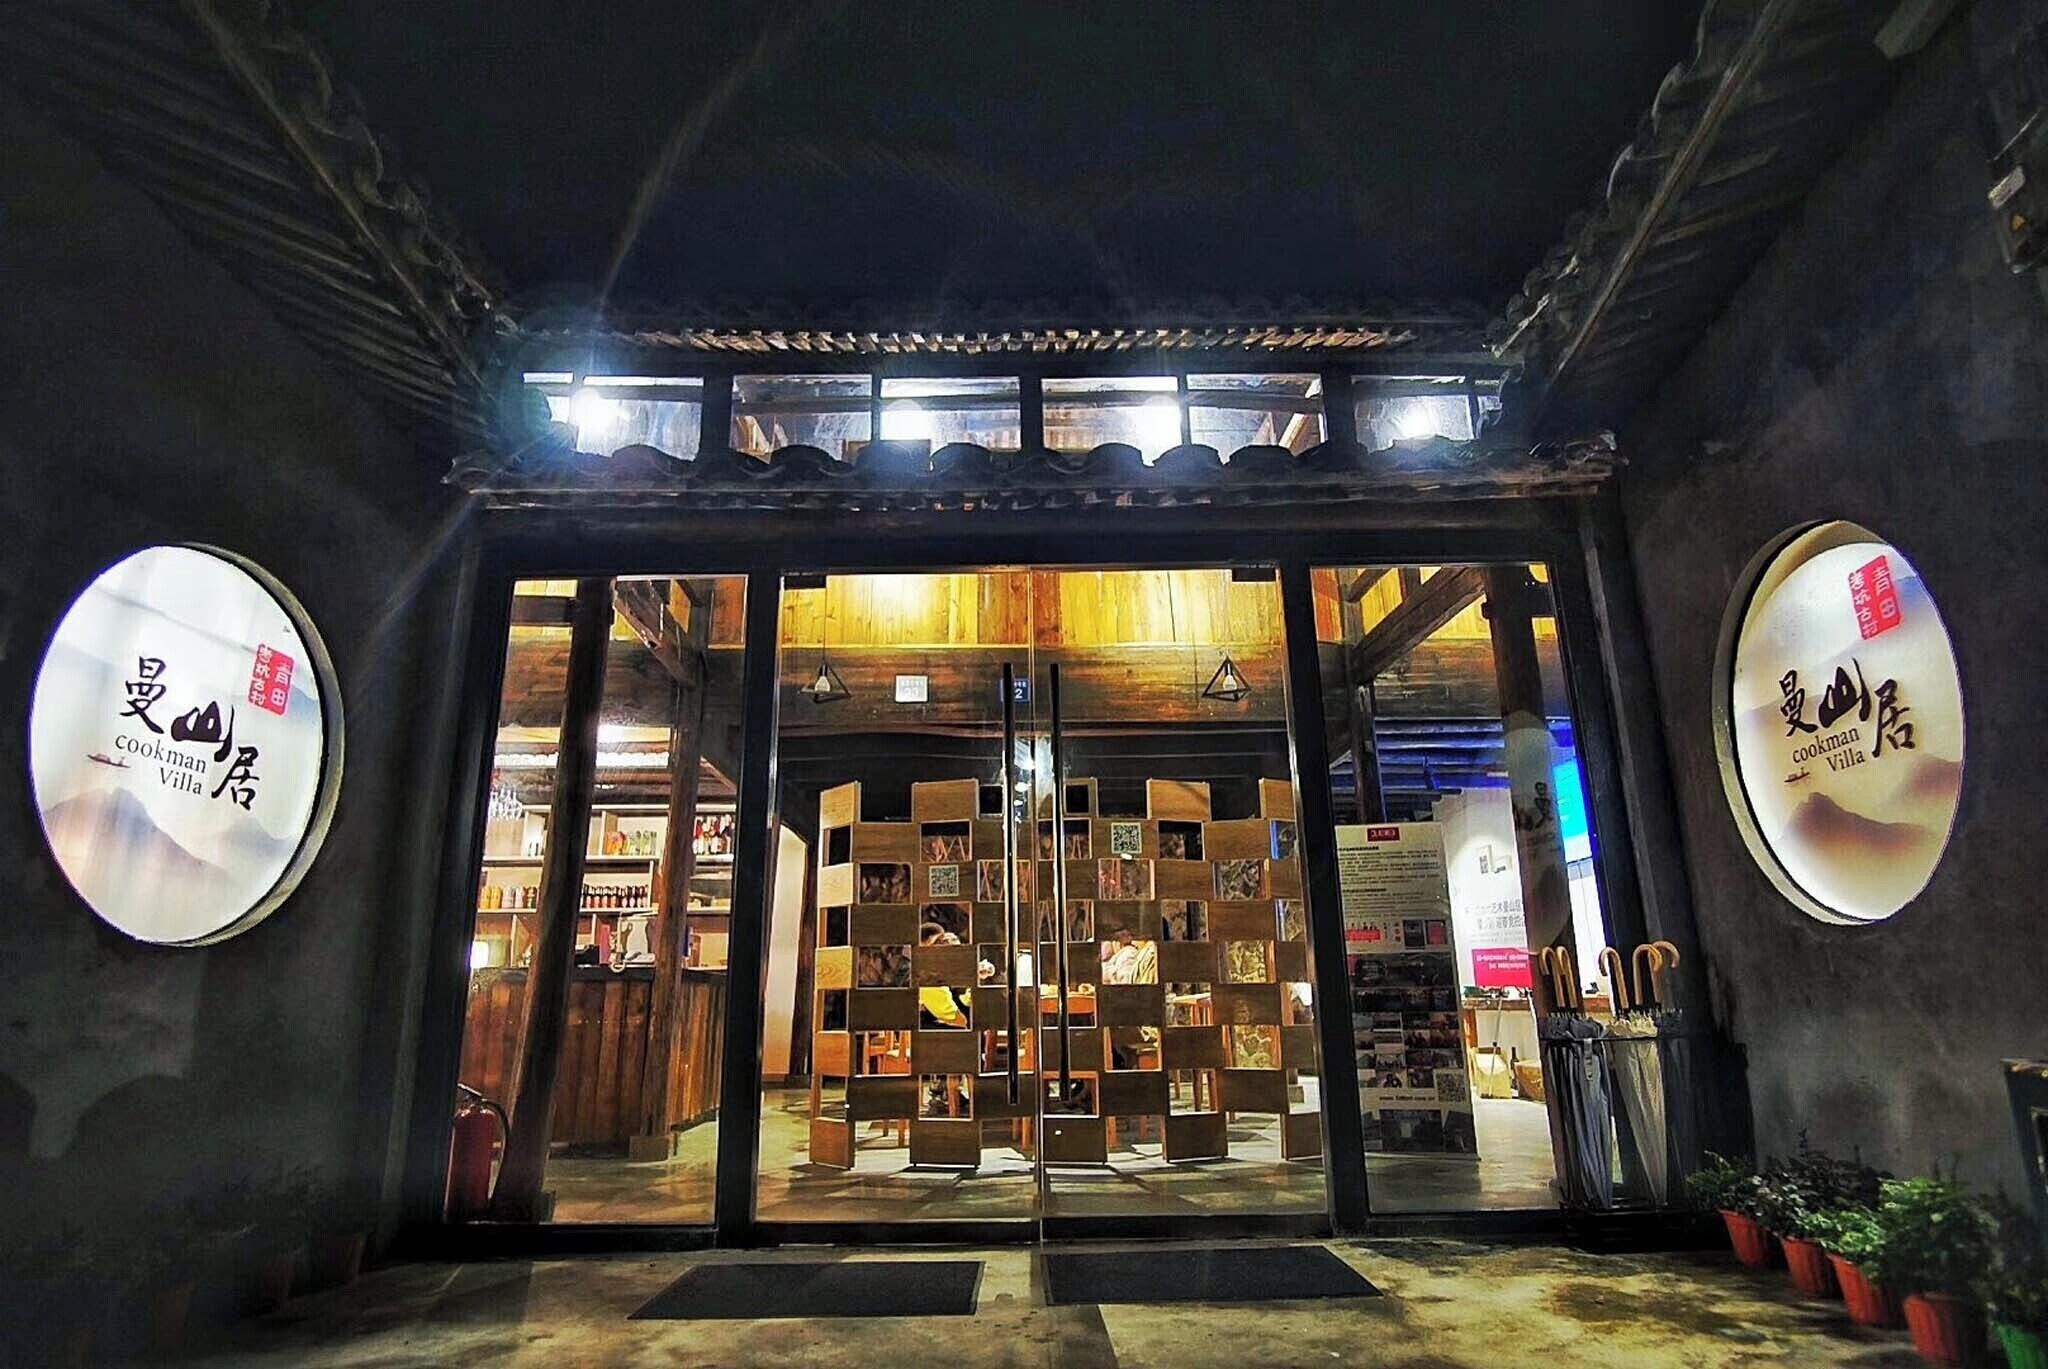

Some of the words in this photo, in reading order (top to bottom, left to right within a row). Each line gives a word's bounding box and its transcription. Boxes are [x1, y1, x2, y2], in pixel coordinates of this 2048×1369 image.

[1778, 657, 1916, 758] 曼山居
[120, 656, 261, 811] 曼山居
[1793, 728, 1859, 763] cookman
[115, 734, 206, 773] cookman
[1826, 748, 1866, 774] Villa
[159, 767, 202, 795] Villa
